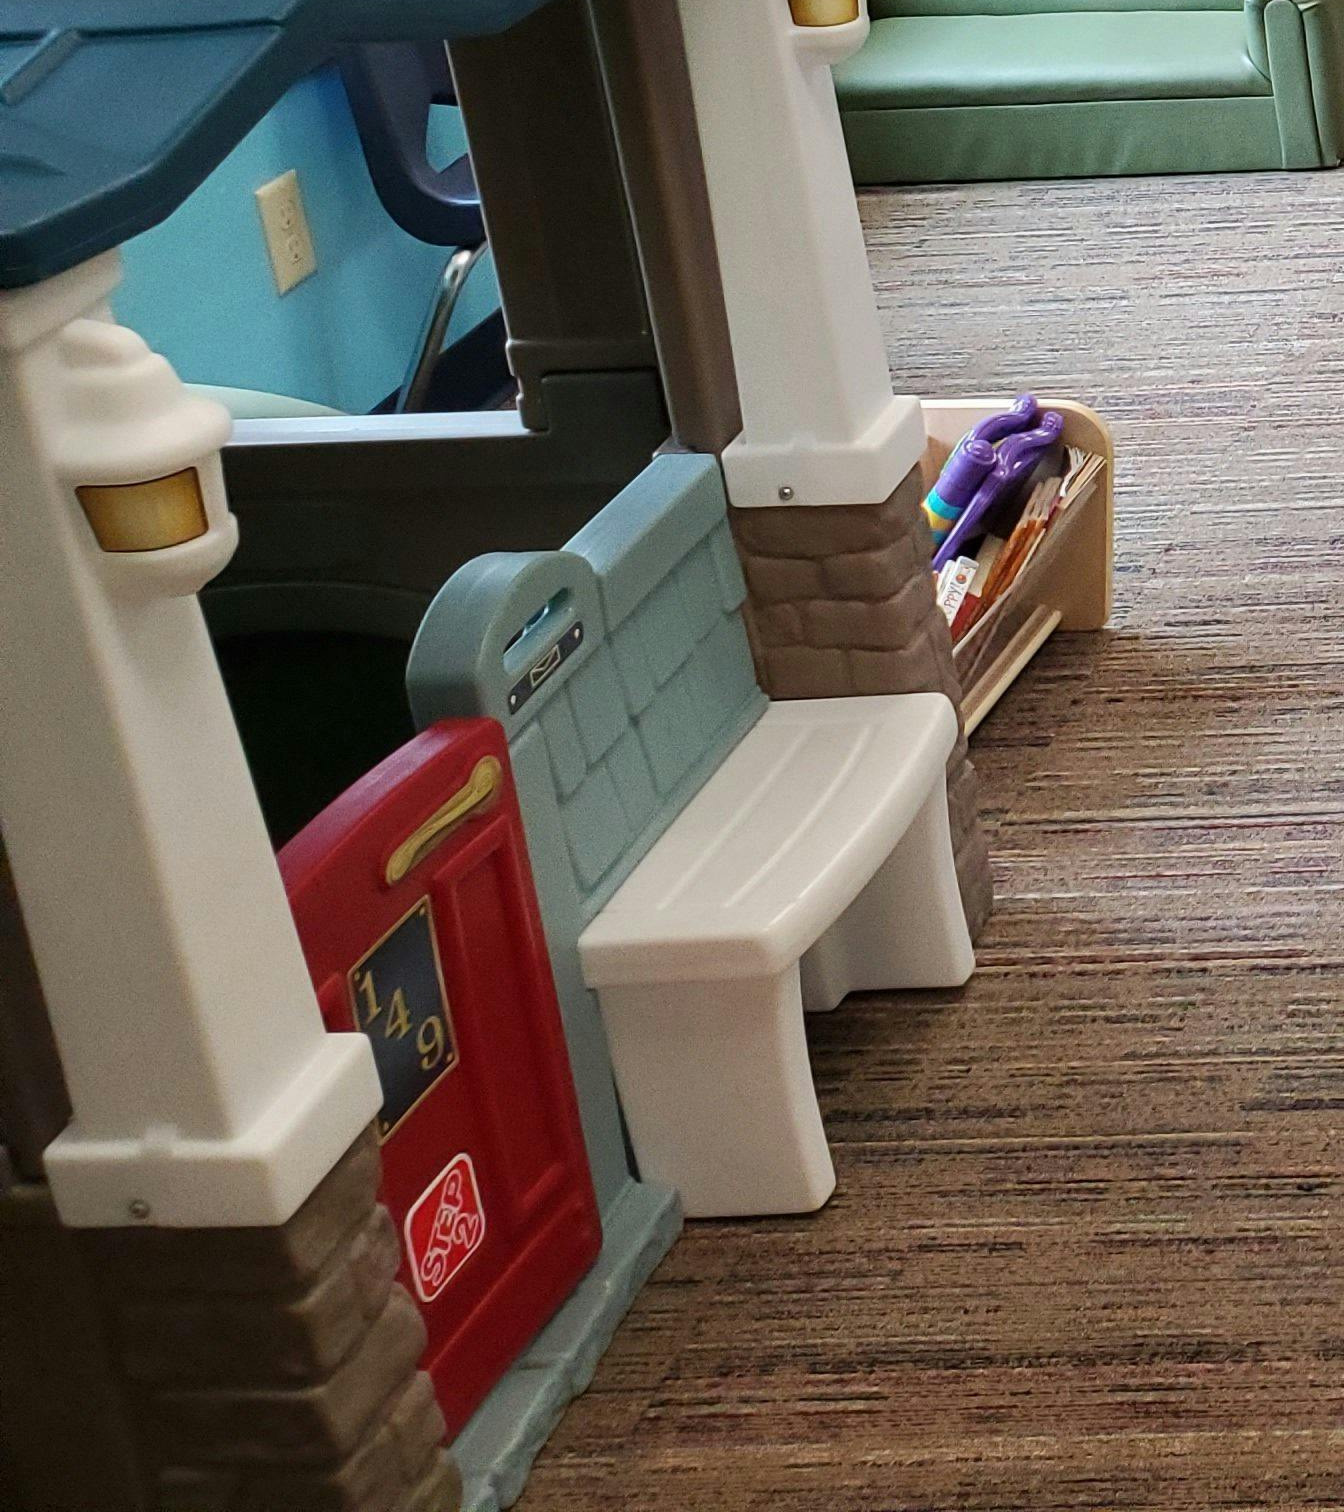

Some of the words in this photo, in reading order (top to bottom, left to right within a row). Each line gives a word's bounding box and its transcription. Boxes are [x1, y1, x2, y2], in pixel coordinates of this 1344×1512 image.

[359, 970, 444, 1070] 149
[421, 1169, 463, 1286] STEP
[452, 1212, 479, 1249] 2
